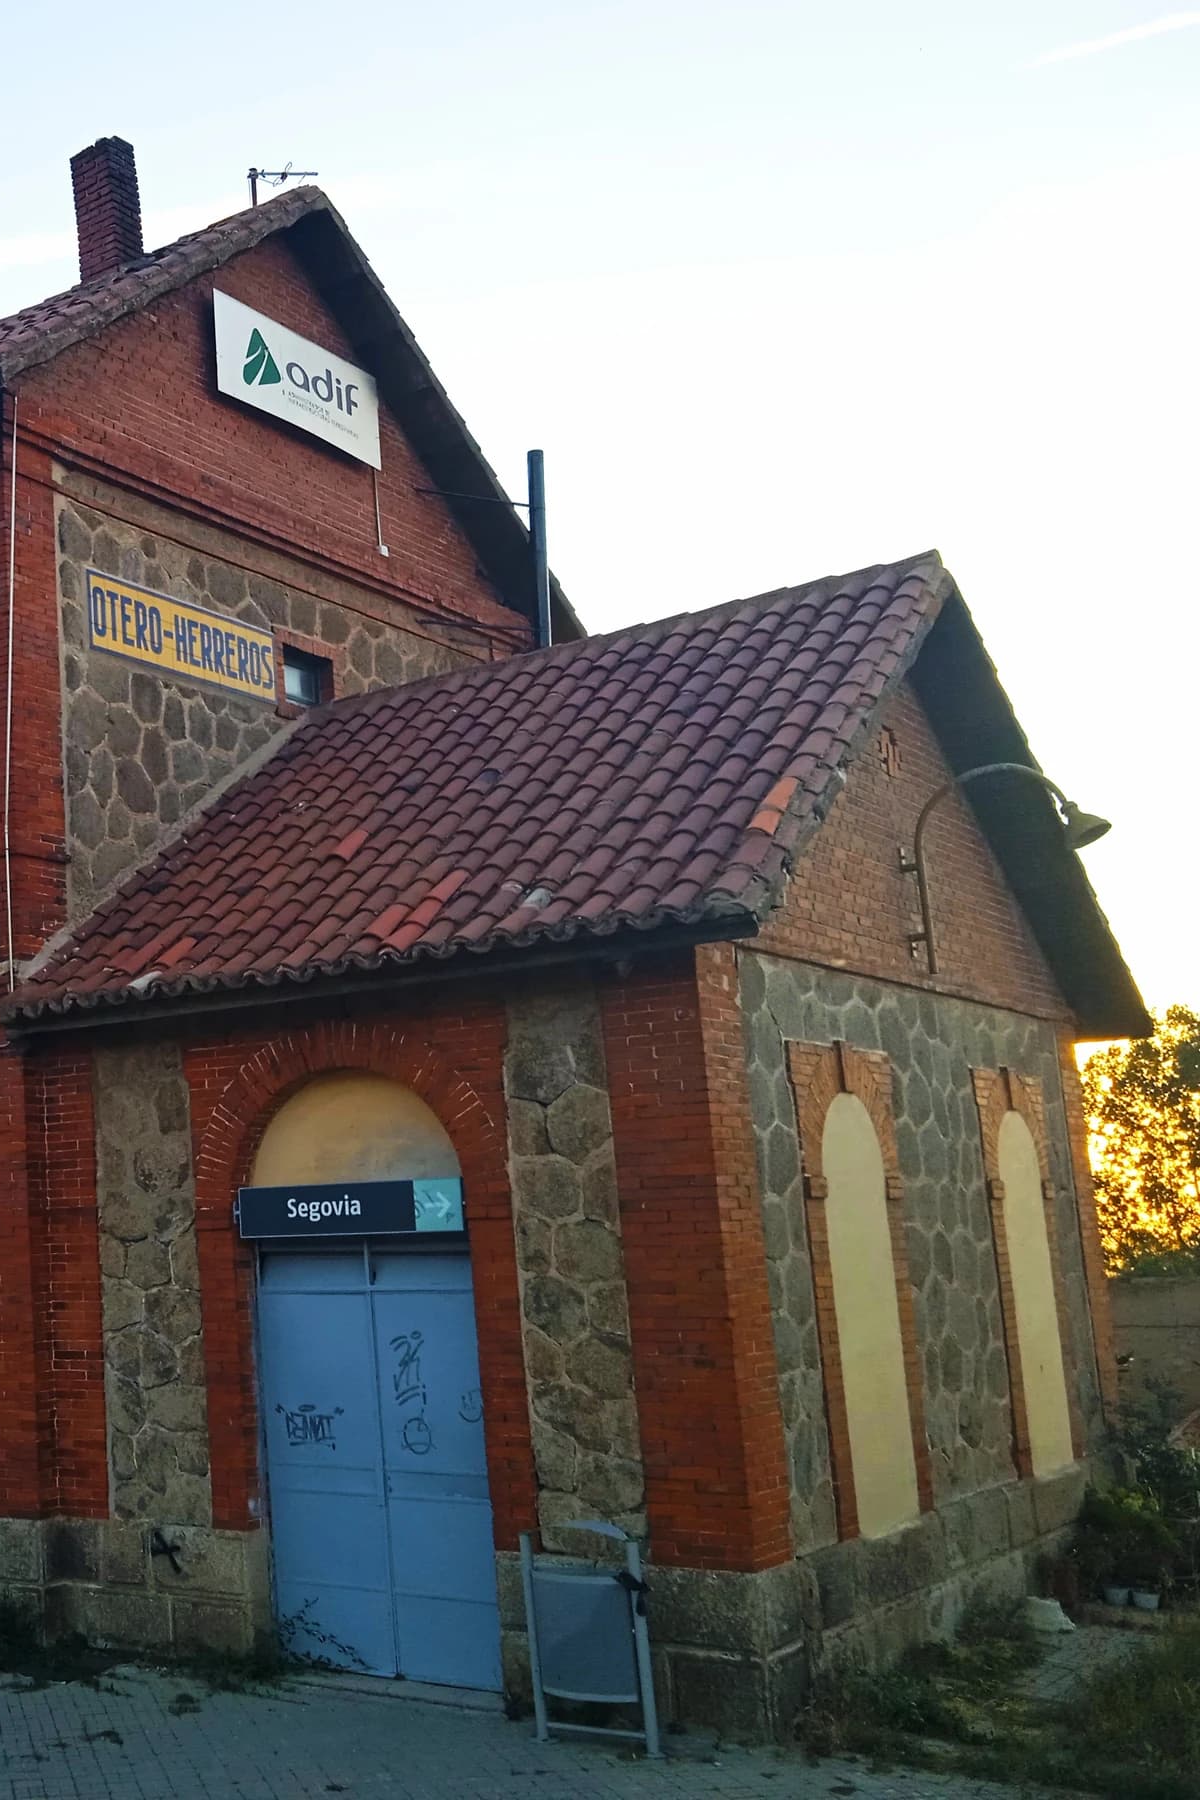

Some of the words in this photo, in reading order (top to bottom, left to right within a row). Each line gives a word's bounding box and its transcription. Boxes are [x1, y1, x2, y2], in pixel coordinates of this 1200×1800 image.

[286, 362, 358, 415] adif
[92, 586, 275, 689] OTERO-HERREROS
[287, 1194, 361, 1222] Segovia
